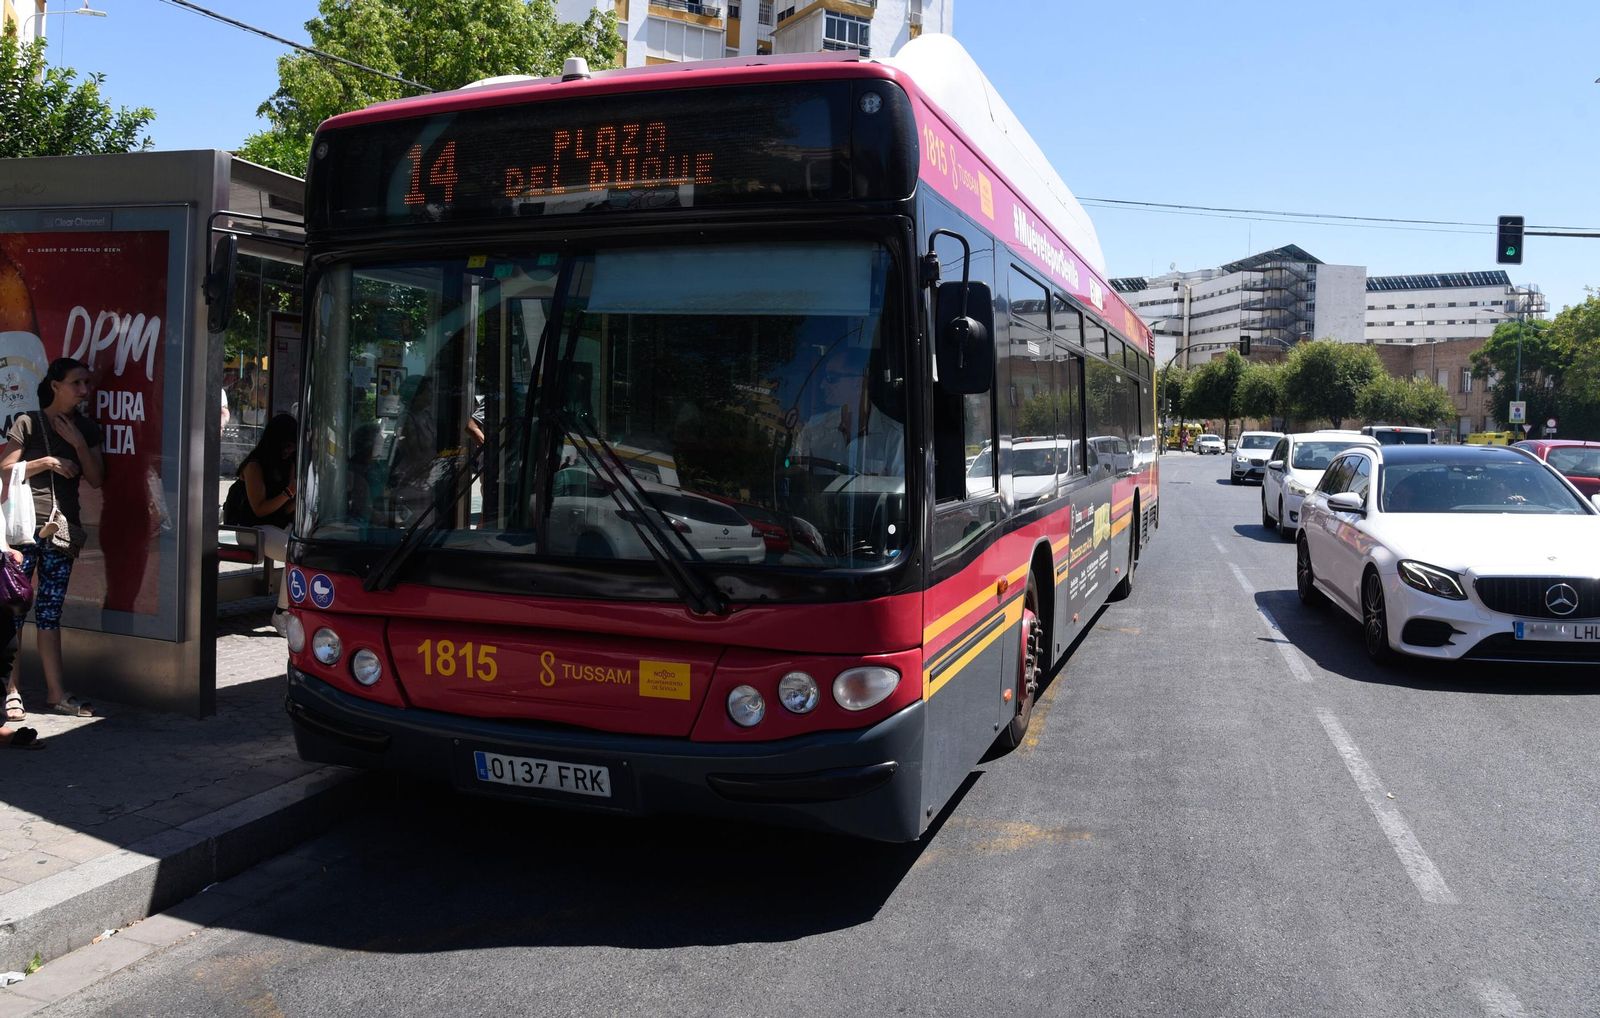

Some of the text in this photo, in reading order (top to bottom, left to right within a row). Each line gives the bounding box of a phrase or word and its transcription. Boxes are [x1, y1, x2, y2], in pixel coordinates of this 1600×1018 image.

[552, 122, 668, 160] PLAZA
[923, 123, 980, 195] 1815 TUSSAM
[403, 140, 459, 205] 14
[503, 152, 714, 198] DEL DUQUE
[62, 305, 161, 382] DPM
[96, 390, 146, 421] PURA
[102, 424, 136, 455] LTA
[417, 639, 498, 682] 1815
[562, 663, 632, 685] TUSSAM
[490, 757, 605, 794] 0137 FRK
